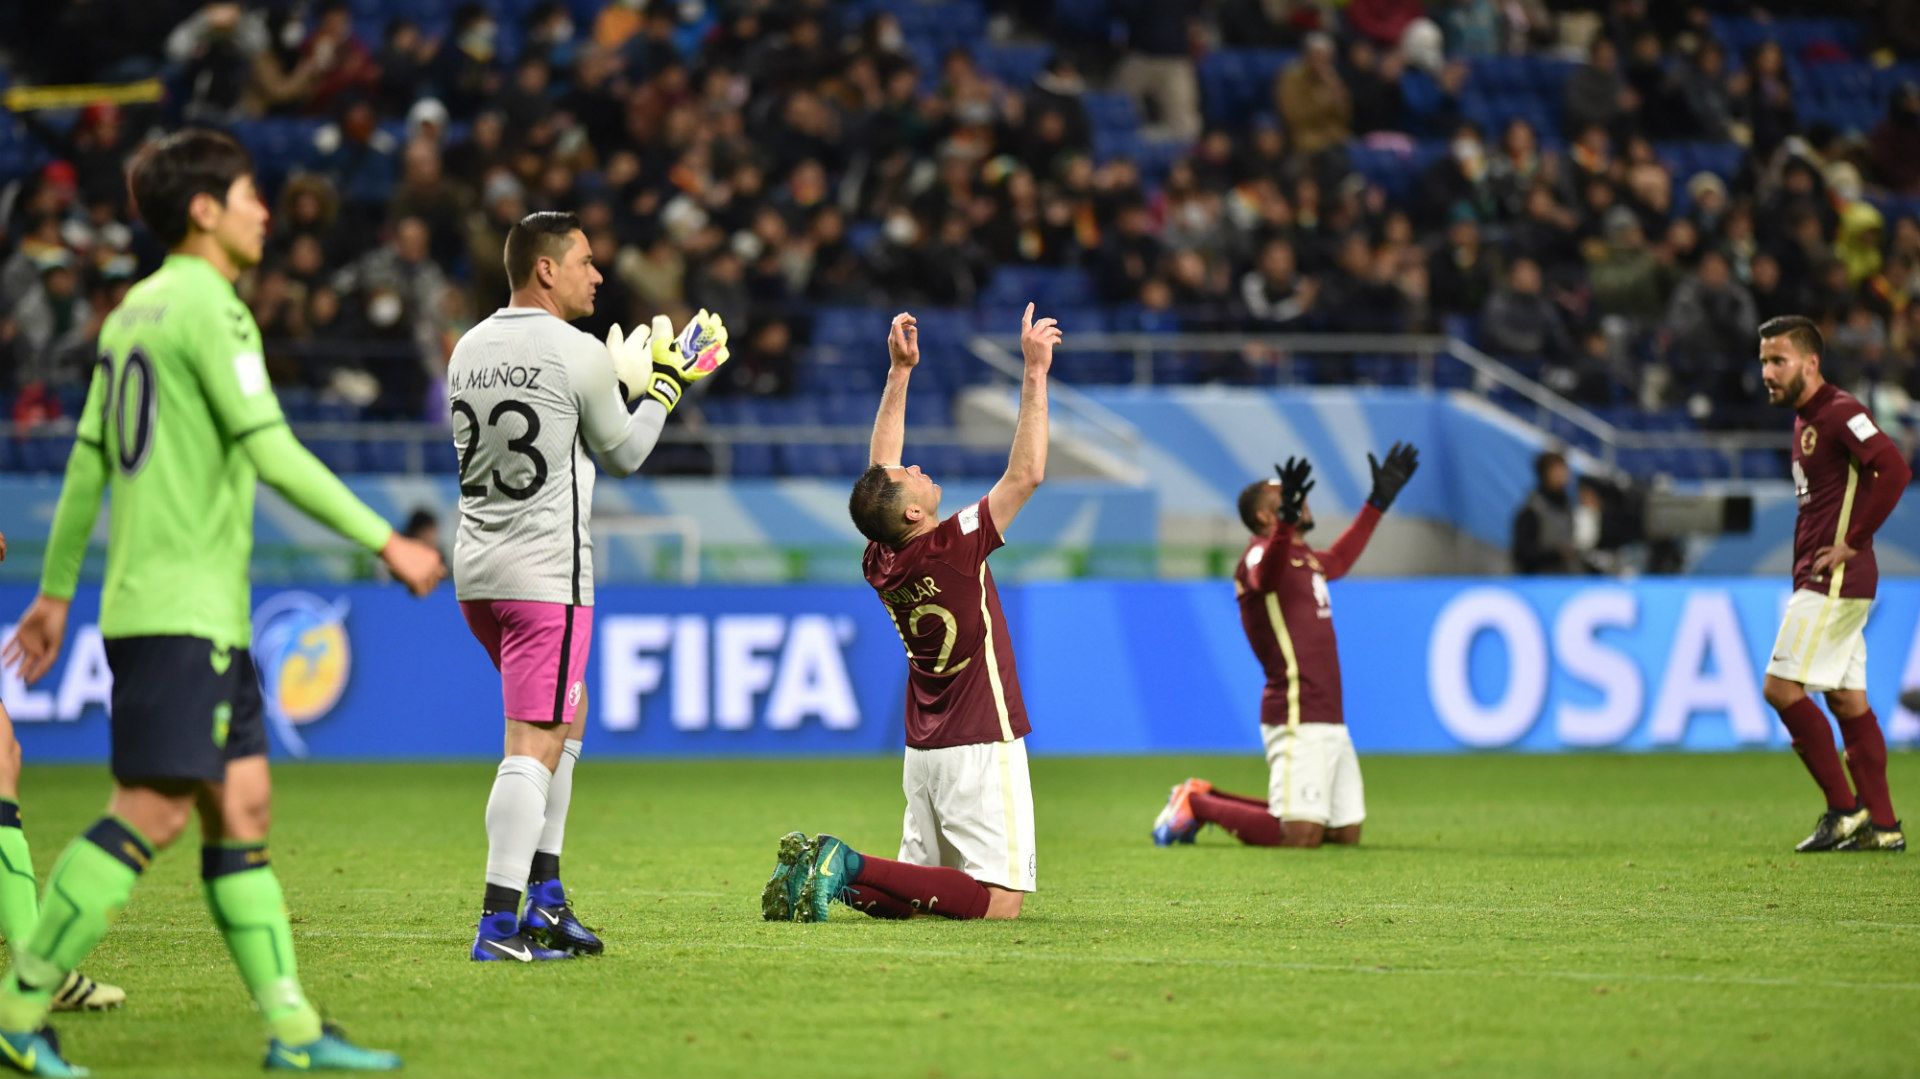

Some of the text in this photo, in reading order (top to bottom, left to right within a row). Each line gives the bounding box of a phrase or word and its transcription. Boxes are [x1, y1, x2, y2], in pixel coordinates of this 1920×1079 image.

[465, 362, 541, 390] MUÑOZ
[451, 398, 547, 501] 23
[882, 576, 942, 604] UILAR
[600, 613, 861, 731] FIFA
[1427, 587, 1920, 747] OSA
